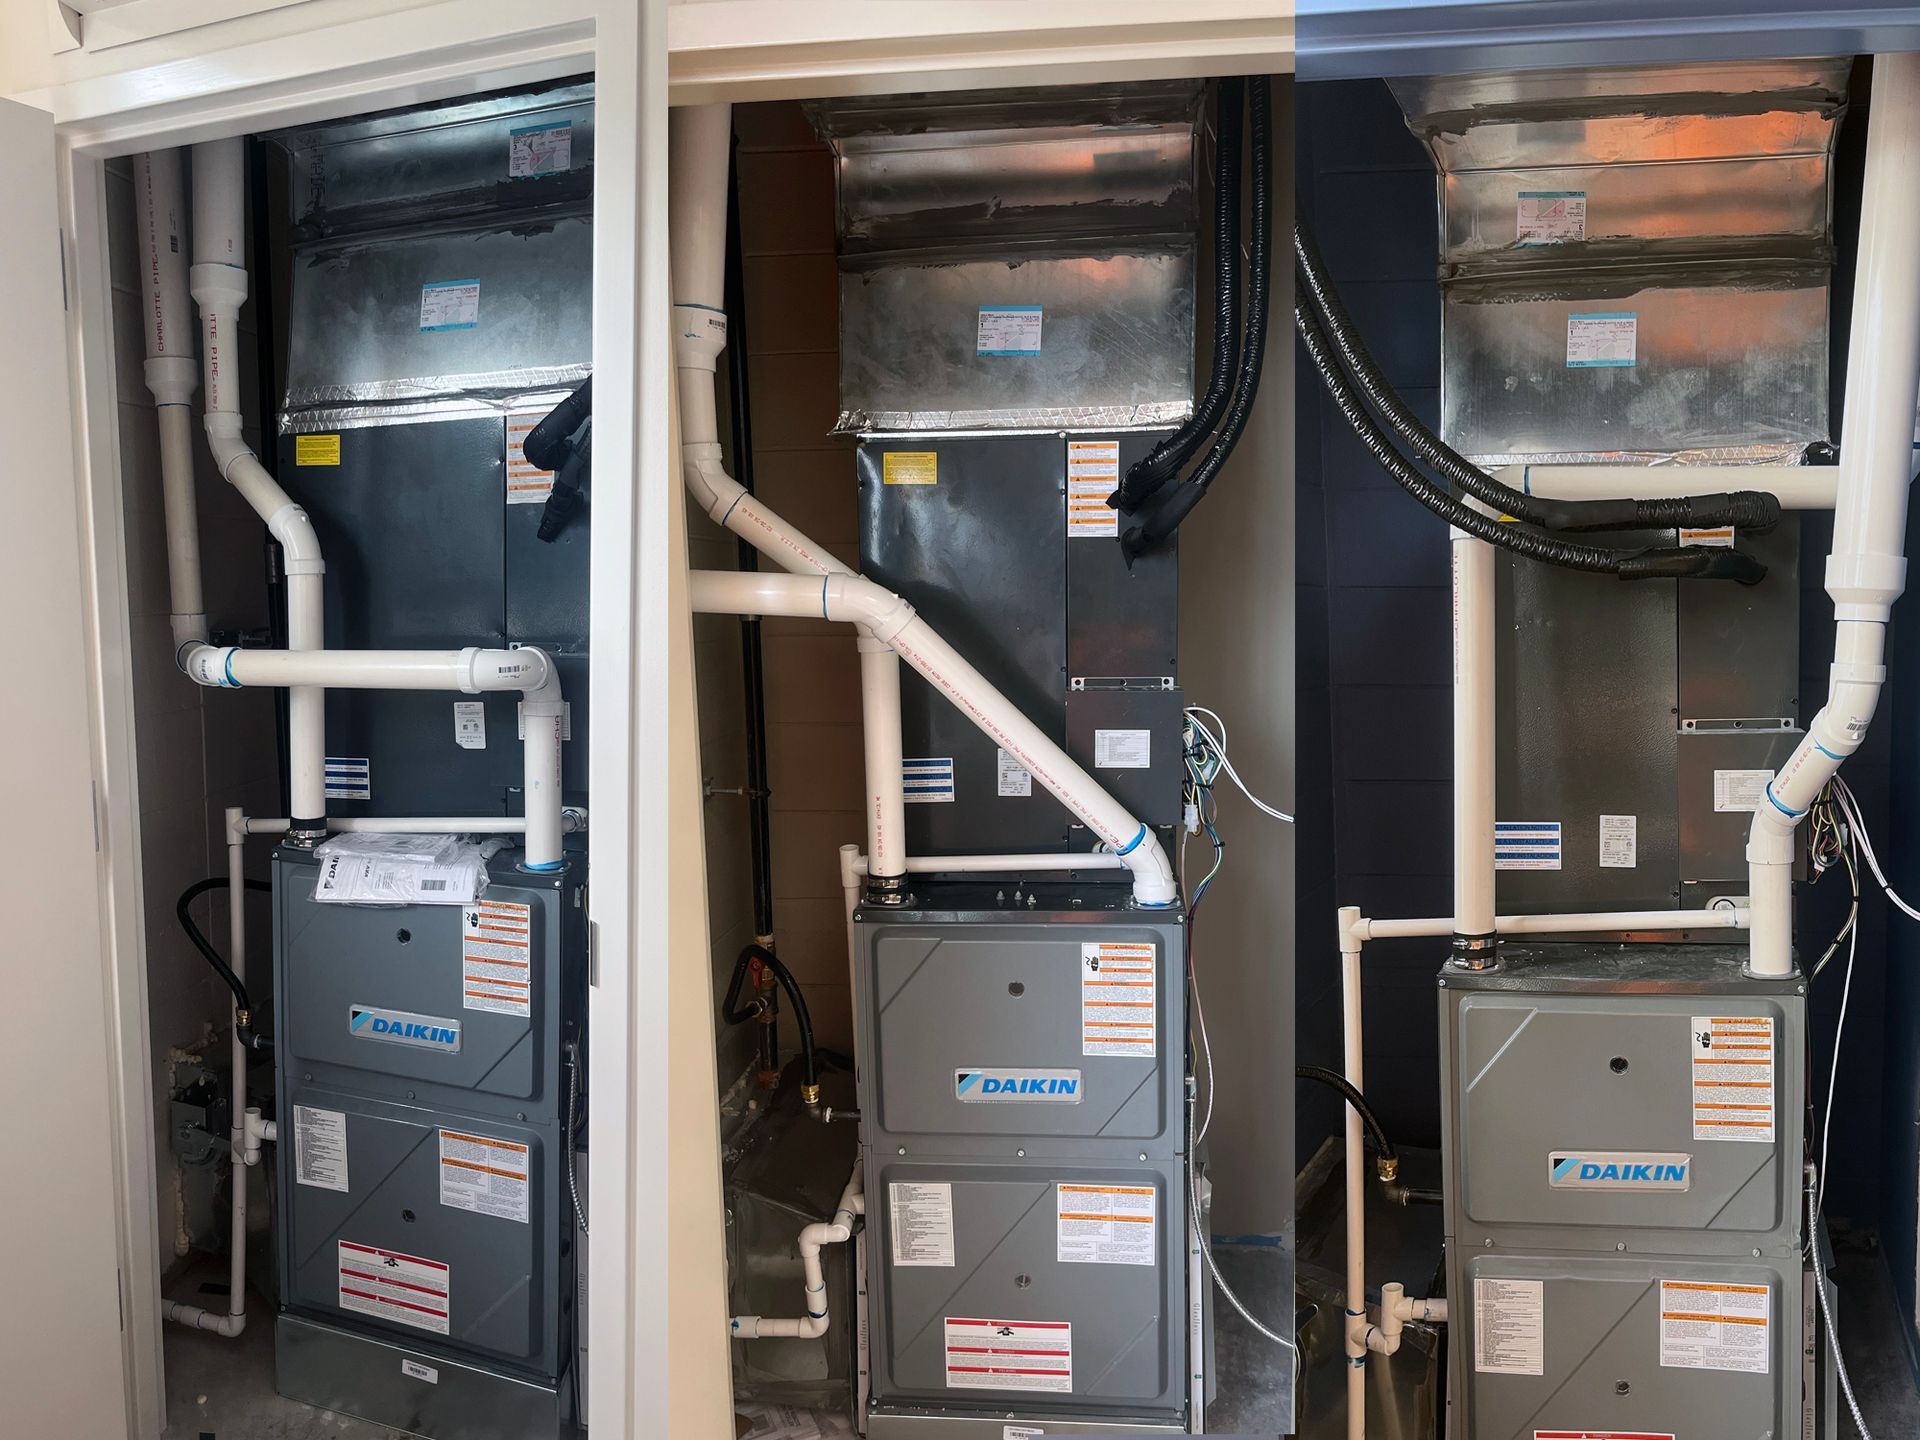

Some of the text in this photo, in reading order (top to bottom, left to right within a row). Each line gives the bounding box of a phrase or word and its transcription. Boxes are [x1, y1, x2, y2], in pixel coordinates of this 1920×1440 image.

[152, 256, 166, 352] CHARLOTTE PIPE
[328, 855, 340, 879] DAI
[372, 1018, 457, 1044] DAIKIN
[981, 1078, 1078, 1095] DAIKIN
[1579, 1163, 1686, 1182] DAIKIN
